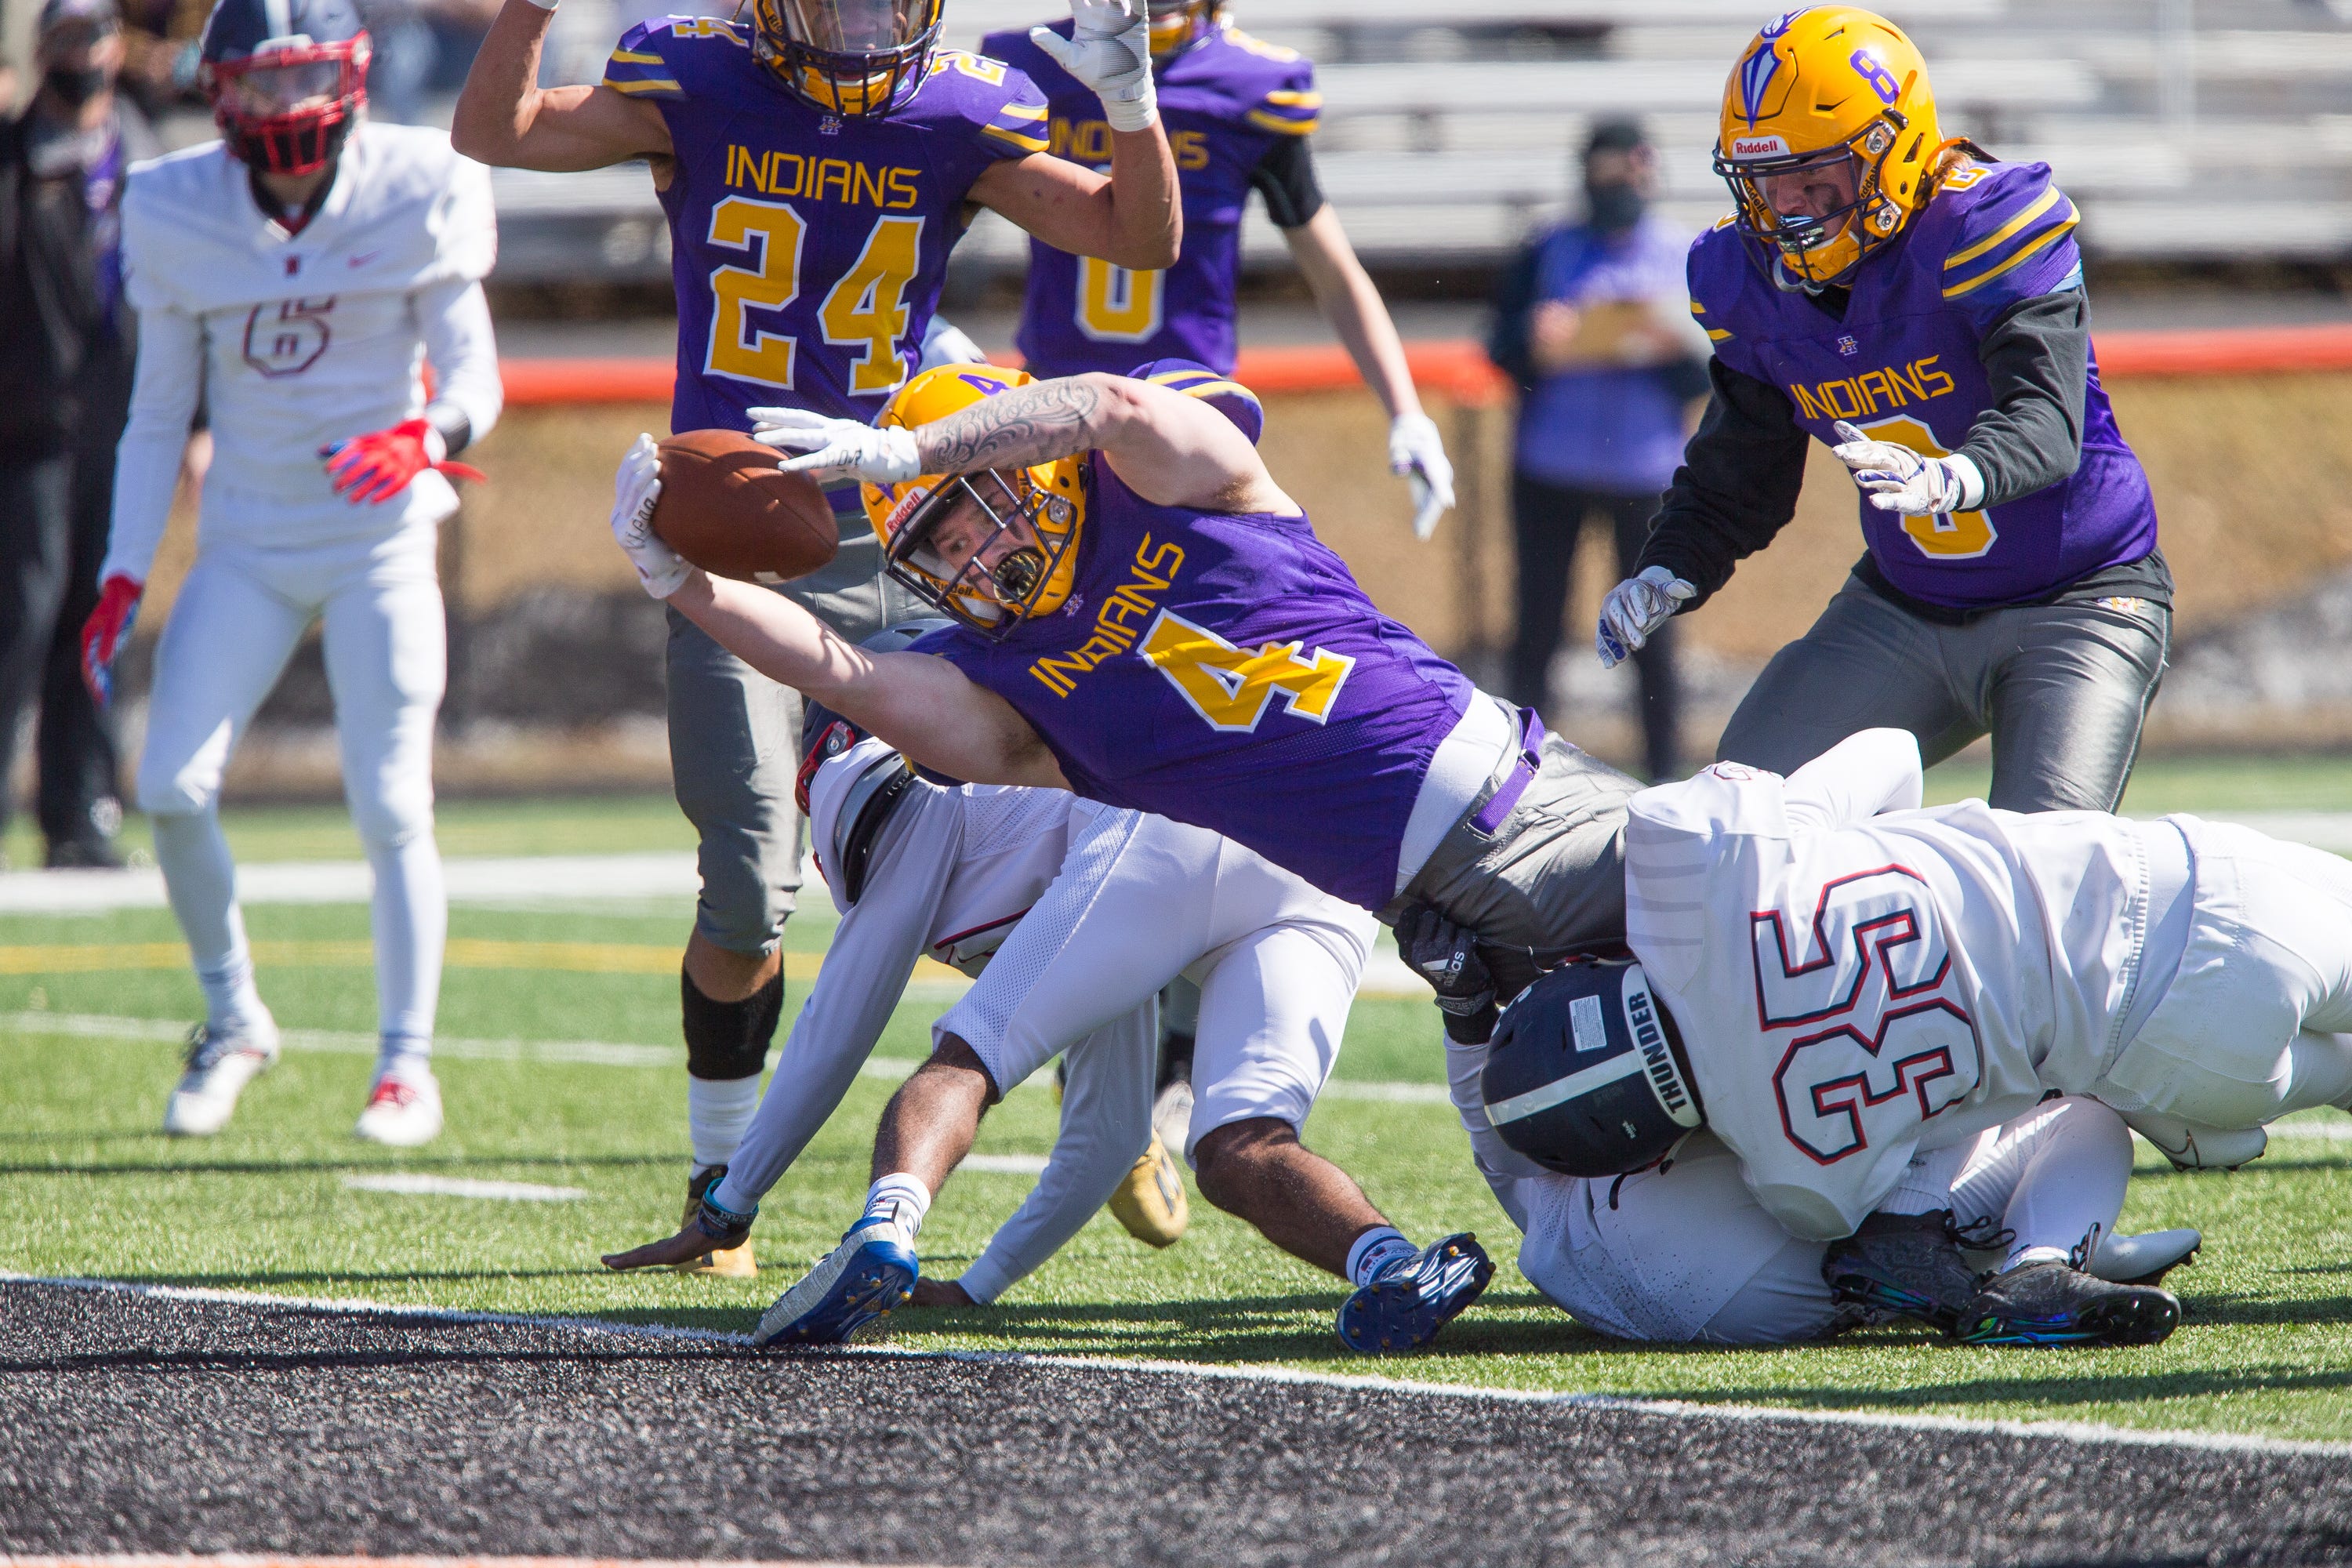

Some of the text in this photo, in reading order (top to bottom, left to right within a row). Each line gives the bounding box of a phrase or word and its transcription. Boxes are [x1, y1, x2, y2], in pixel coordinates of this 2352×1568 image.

[1849, 49, 1900, 105] 8
[724, 144, 922, 209] INDIANS
[1736, 140, 1778, 154] Riddell
[703, 194, 926, 397] 24
[958, 374, 1011, 396] 4
[1790, 354, 1955, 419] INDIANS
[886, 491, 922, 532] Riddell
[1028, 532, 1185, 699] INDIANS
[1136, 607, 1356, 733] 4
[1750, 863, 1981, 1167] 35
[1628, 991, 1688, 1115] THUNDER
